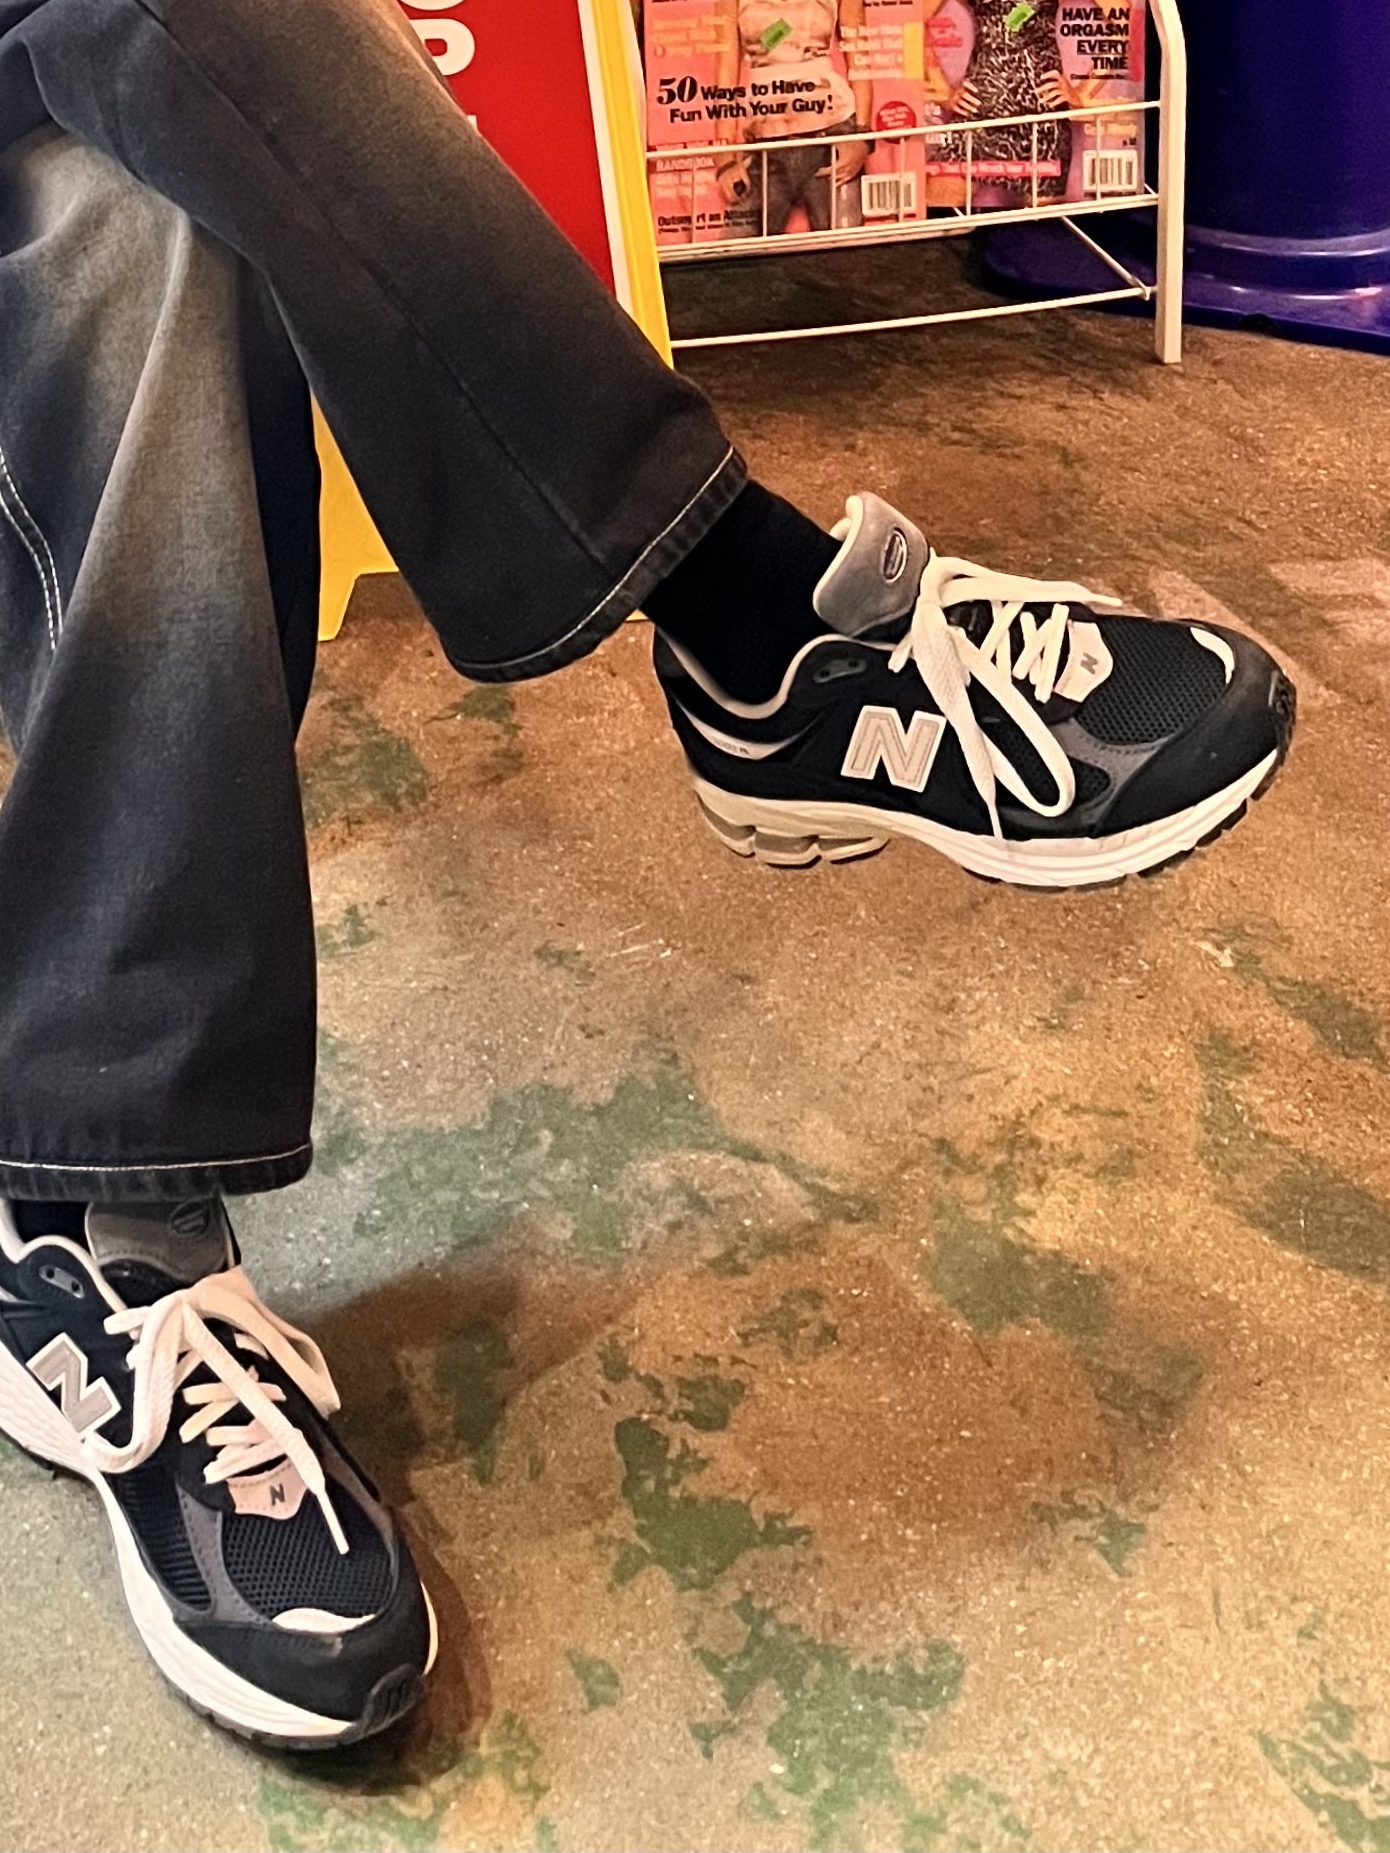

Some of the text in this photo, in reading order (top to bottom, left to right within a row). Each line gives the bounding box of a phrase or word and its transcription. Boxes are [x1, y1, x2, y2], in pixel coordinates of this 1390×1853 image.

[1062, 7, 1130, 21] HAVE AN
[1060, 23, 1129, 37] ORGASM
[1076, 40, 1130, 54] EVERY
[1091, 57, 1129, 70] TIME
[656, 75, 816, 105] 50 Ways to Have
[670, 94, 833, 123] Fun With Your Guy!
[1078, 653, 1097, 674] N
[841, 706, 946, 791] N
[26, 1332, 119, 1436] N
[269, 1484, 285, 1506] N
